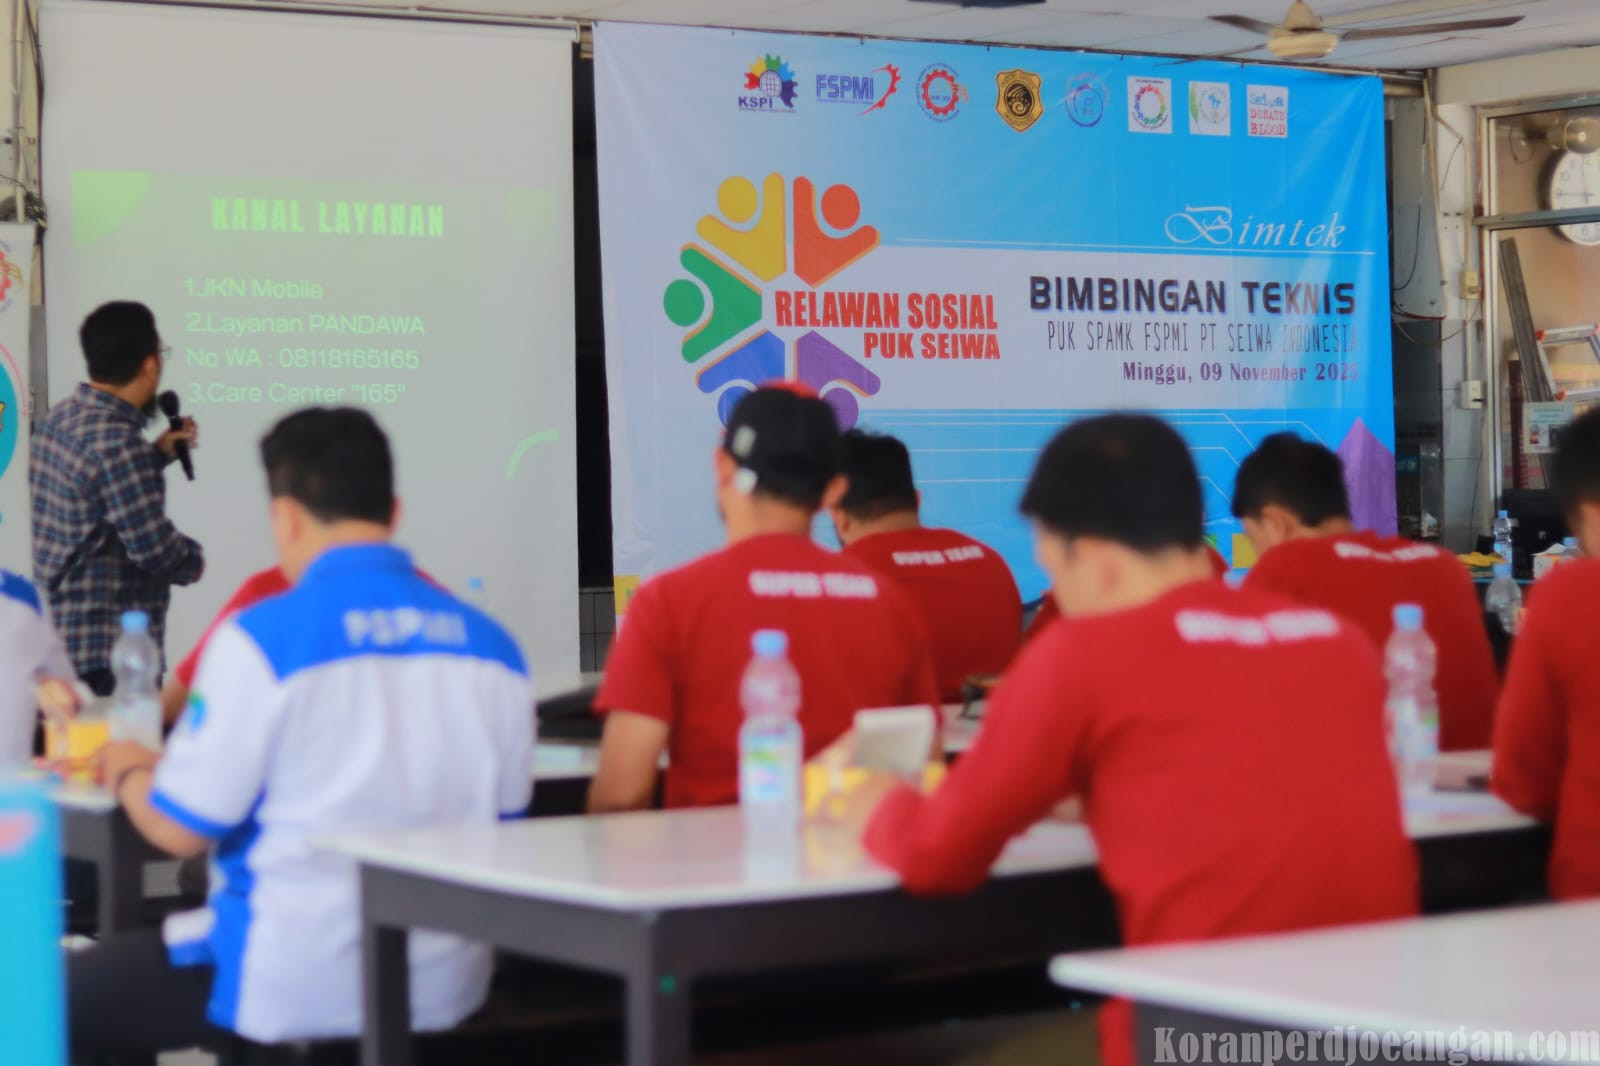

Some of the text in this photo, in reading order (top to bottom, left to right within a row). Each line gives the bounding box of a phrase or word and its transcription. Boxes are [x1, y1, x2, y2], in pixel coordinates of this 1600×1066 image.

[816, 74, 874, 100] FSPMI
[739, 96, 772, 109] KSPI
[212, 197, 445, 238] KANAL LAYANAN
[1164, 204, 1346, 248] Bimtek
[252, 279, 324, 301] Mobile
[1028, 276, 1356, 316] BIMBINGAN TEKNIS
[775, 291, 998, 330] RELAWAN SOSIAL
[186, 312, 425, 337] 2.Layanan PANDAWA
[1048, 320, 1358, 354] PUK SPAMK FSPMI PT SEIWA INDONESIA
[187, 348, 218, 368] No
[225, 348, 262, 368] WA
[279, 349, 420, 370] 08118165165
[863, 332, 1001, 360] PUK SEIWA
[1123, 361, 1193, 385] Minggu,
[1200, 363, 1223, 382] 09
[1230, 363, 1307, 382] November
[187, 383, 406, 404] 3.Care Center "165"
